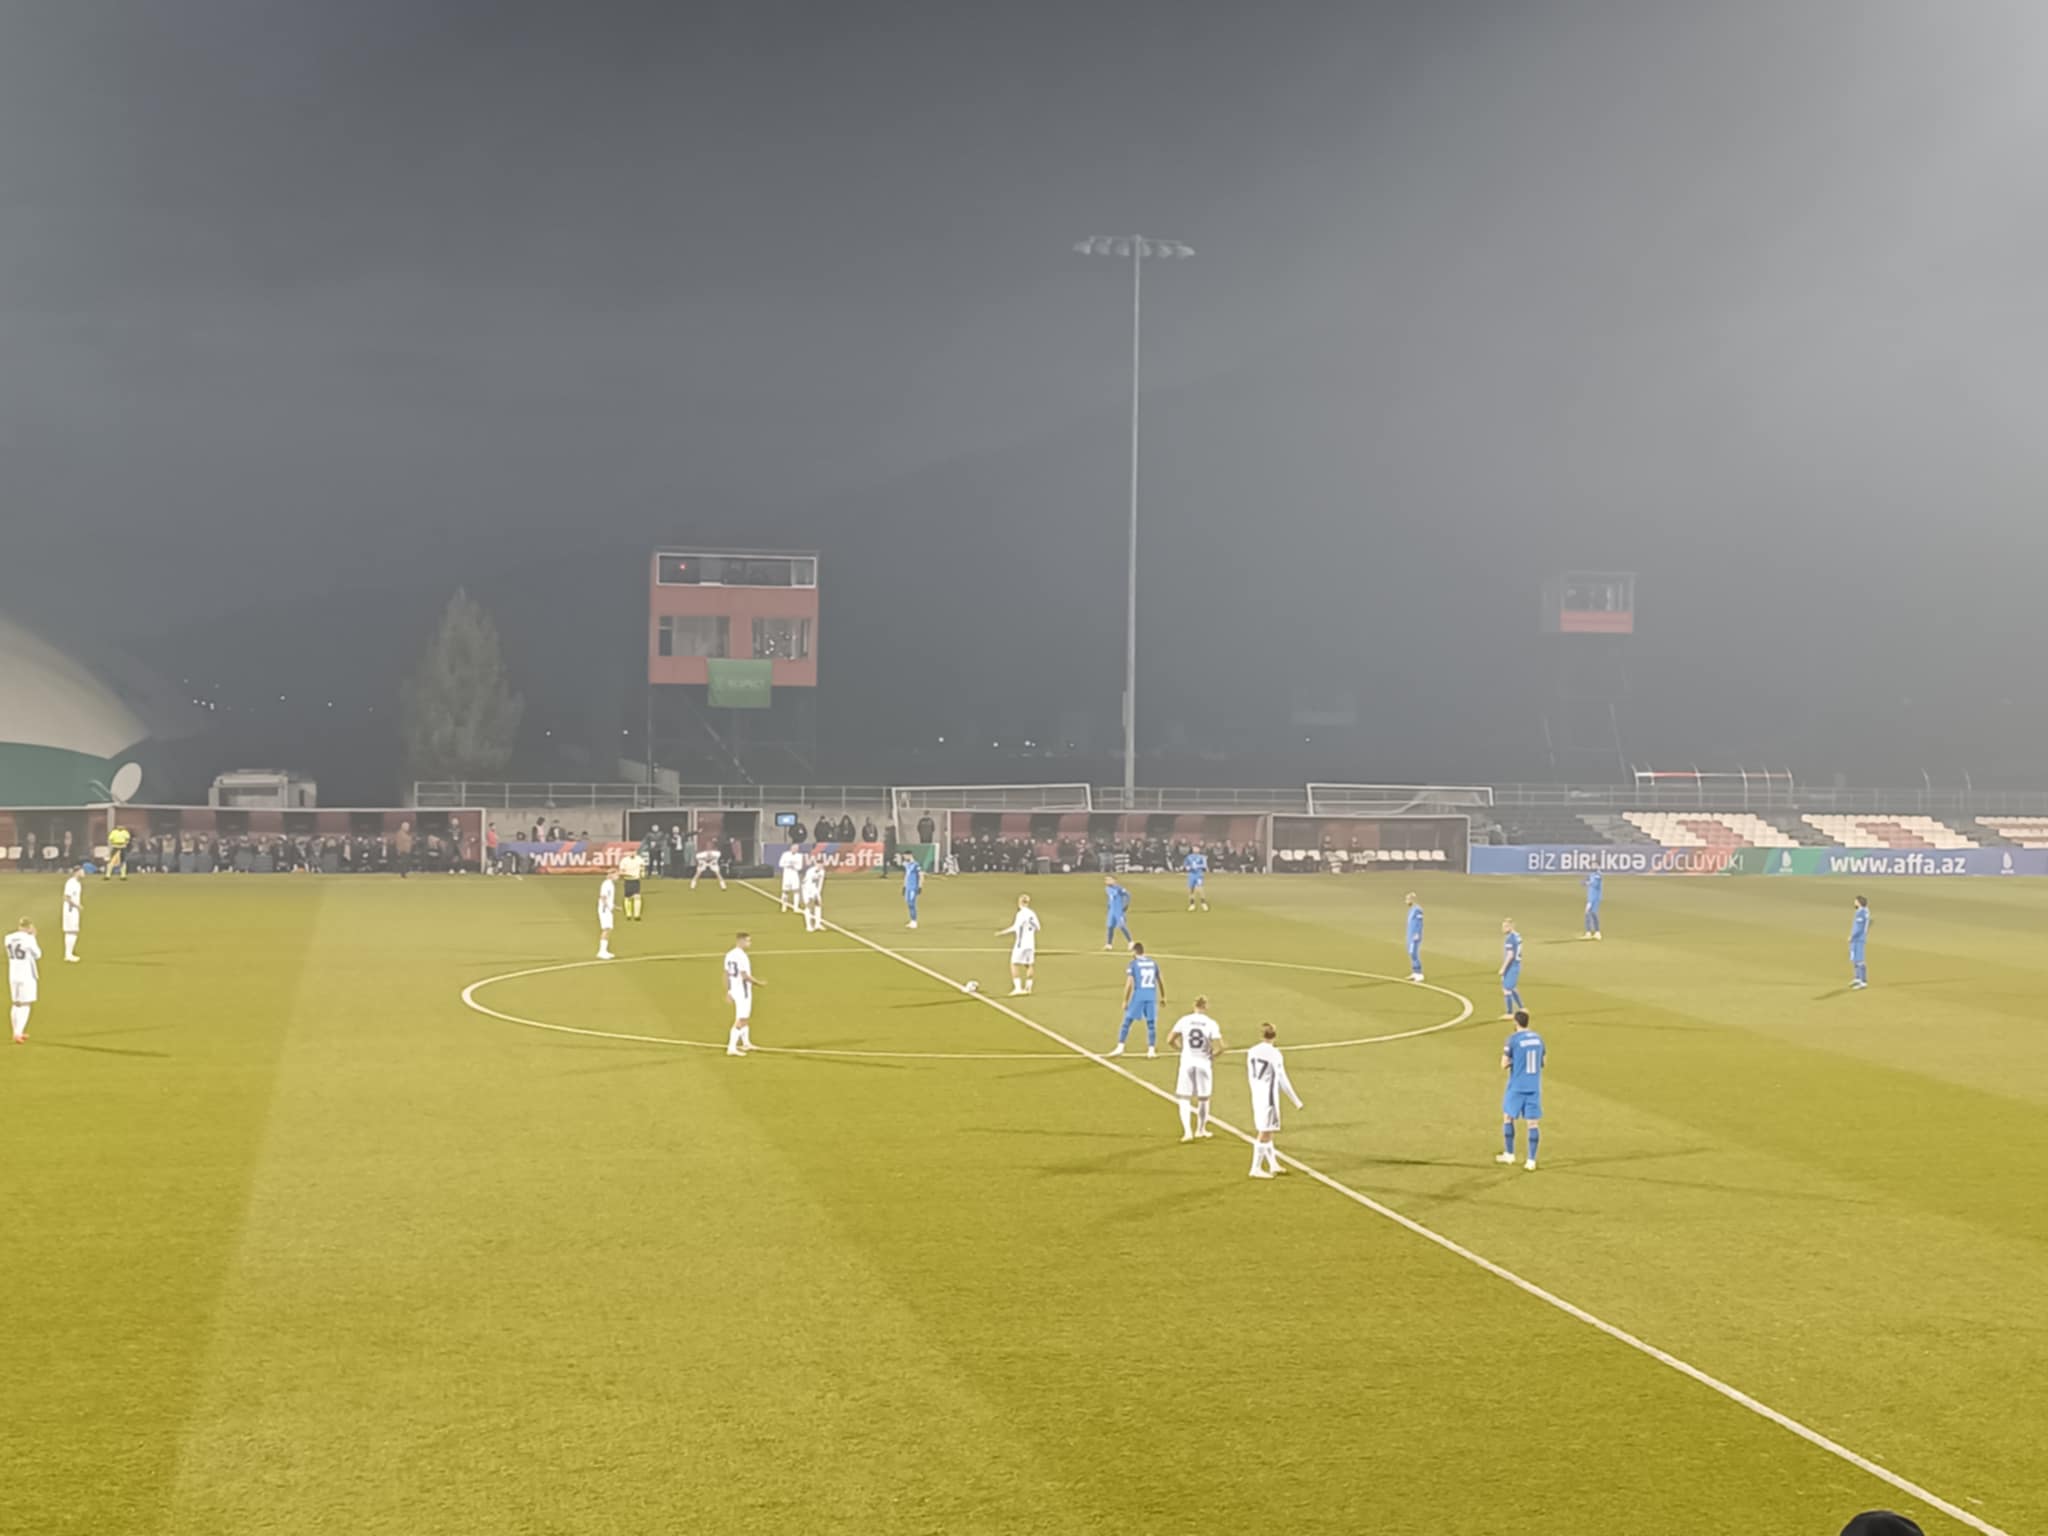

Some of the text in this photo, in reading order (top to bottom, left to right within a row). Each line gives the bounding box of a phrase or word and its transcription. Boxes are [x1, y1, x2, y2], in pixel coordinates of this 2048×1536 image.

[1528, 849, 1556, 870] BİZ
[1830, 853, 1966, 874] www.affa.az
[7, 943, 25, 960] 16
[1140, 967, 1155, 988] 22
[1188, 1028, 1204, 1049] 8
[1250, 1058, 1269, 1080] 17
[1526, 1049, 1537, 1074] 11
